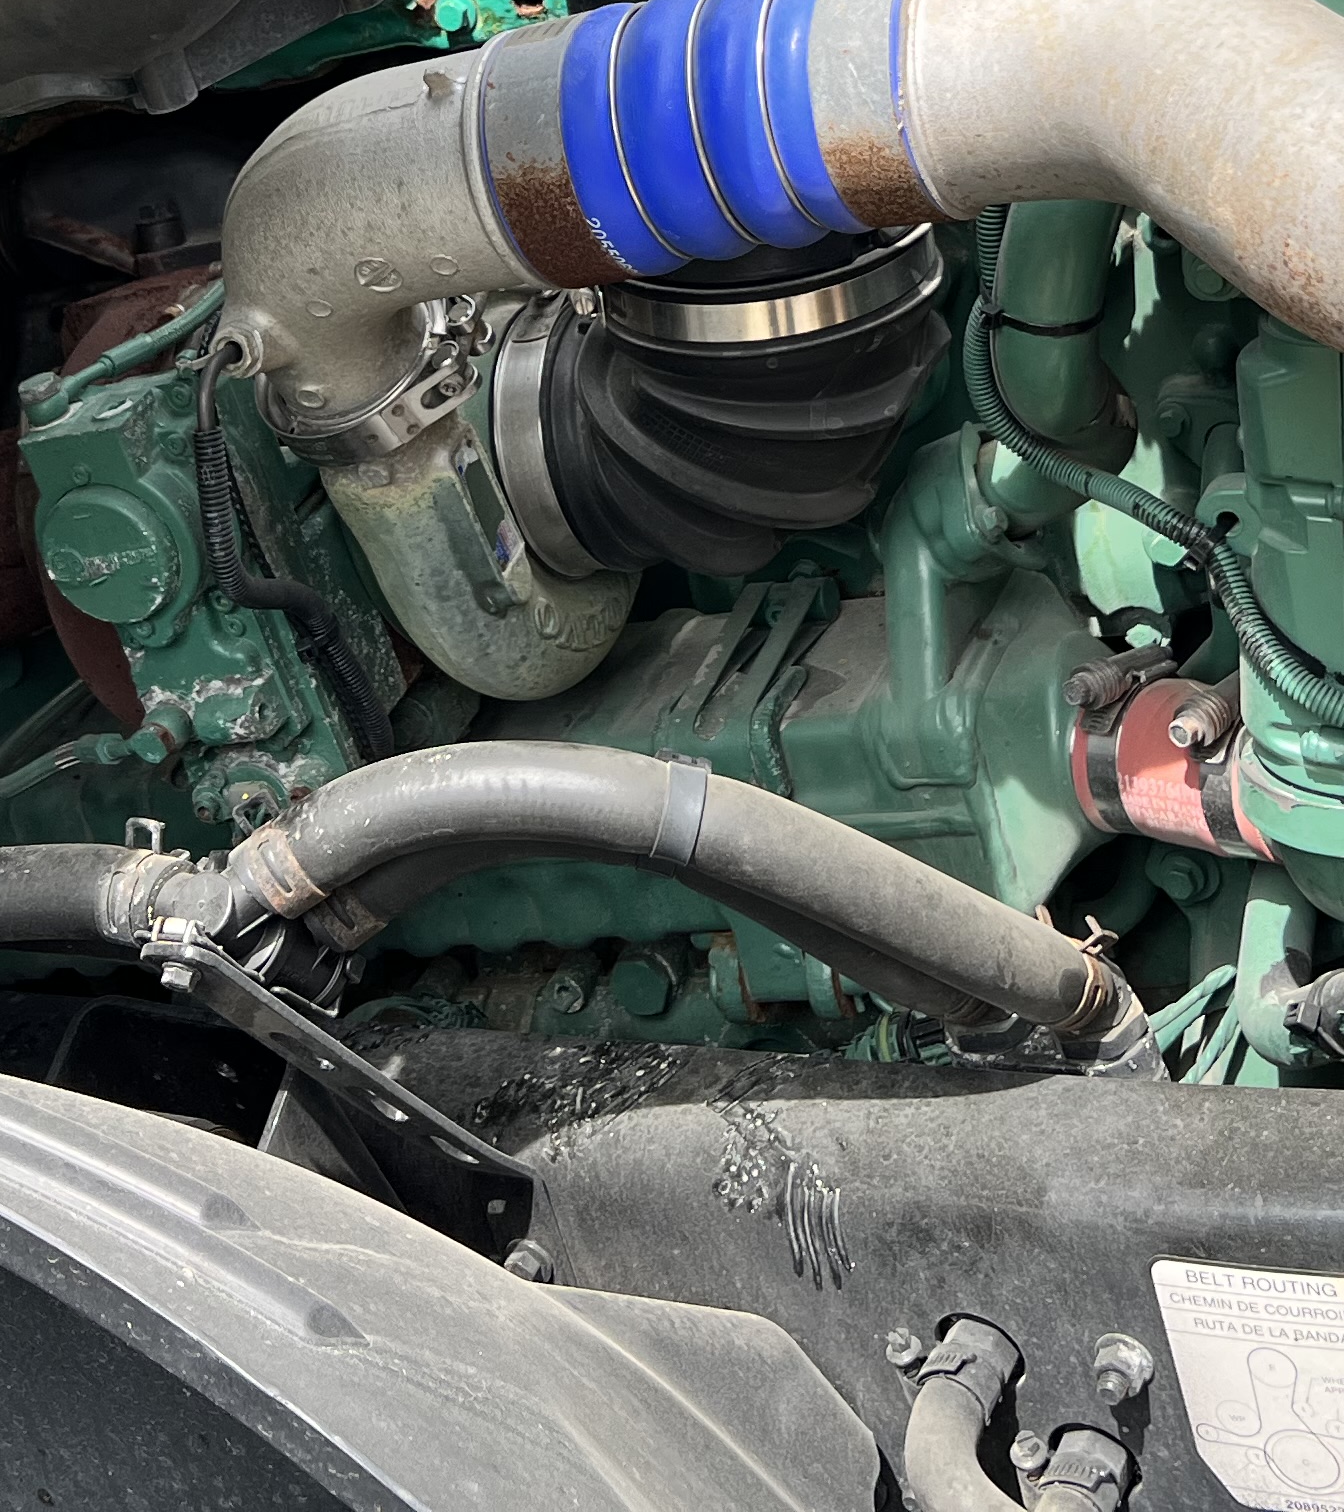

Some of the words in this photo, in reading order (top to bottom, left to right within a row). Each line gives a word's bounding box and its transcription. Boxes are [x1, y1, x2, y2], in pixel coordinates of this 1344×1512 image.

[1185, 1269, 1234, 1288] BELT
[1242, 1275, 1338, 1298] ROUTING
[1169, 1292, 1232, 1311] CHEMIN
[1237, 1300, 1260, 1314] DE
[1194, 1317, 1238, 1333] RUTA
[1242, 1322, 1265, 1336] DE
[1269, 1326, 1290, 1340] LA
